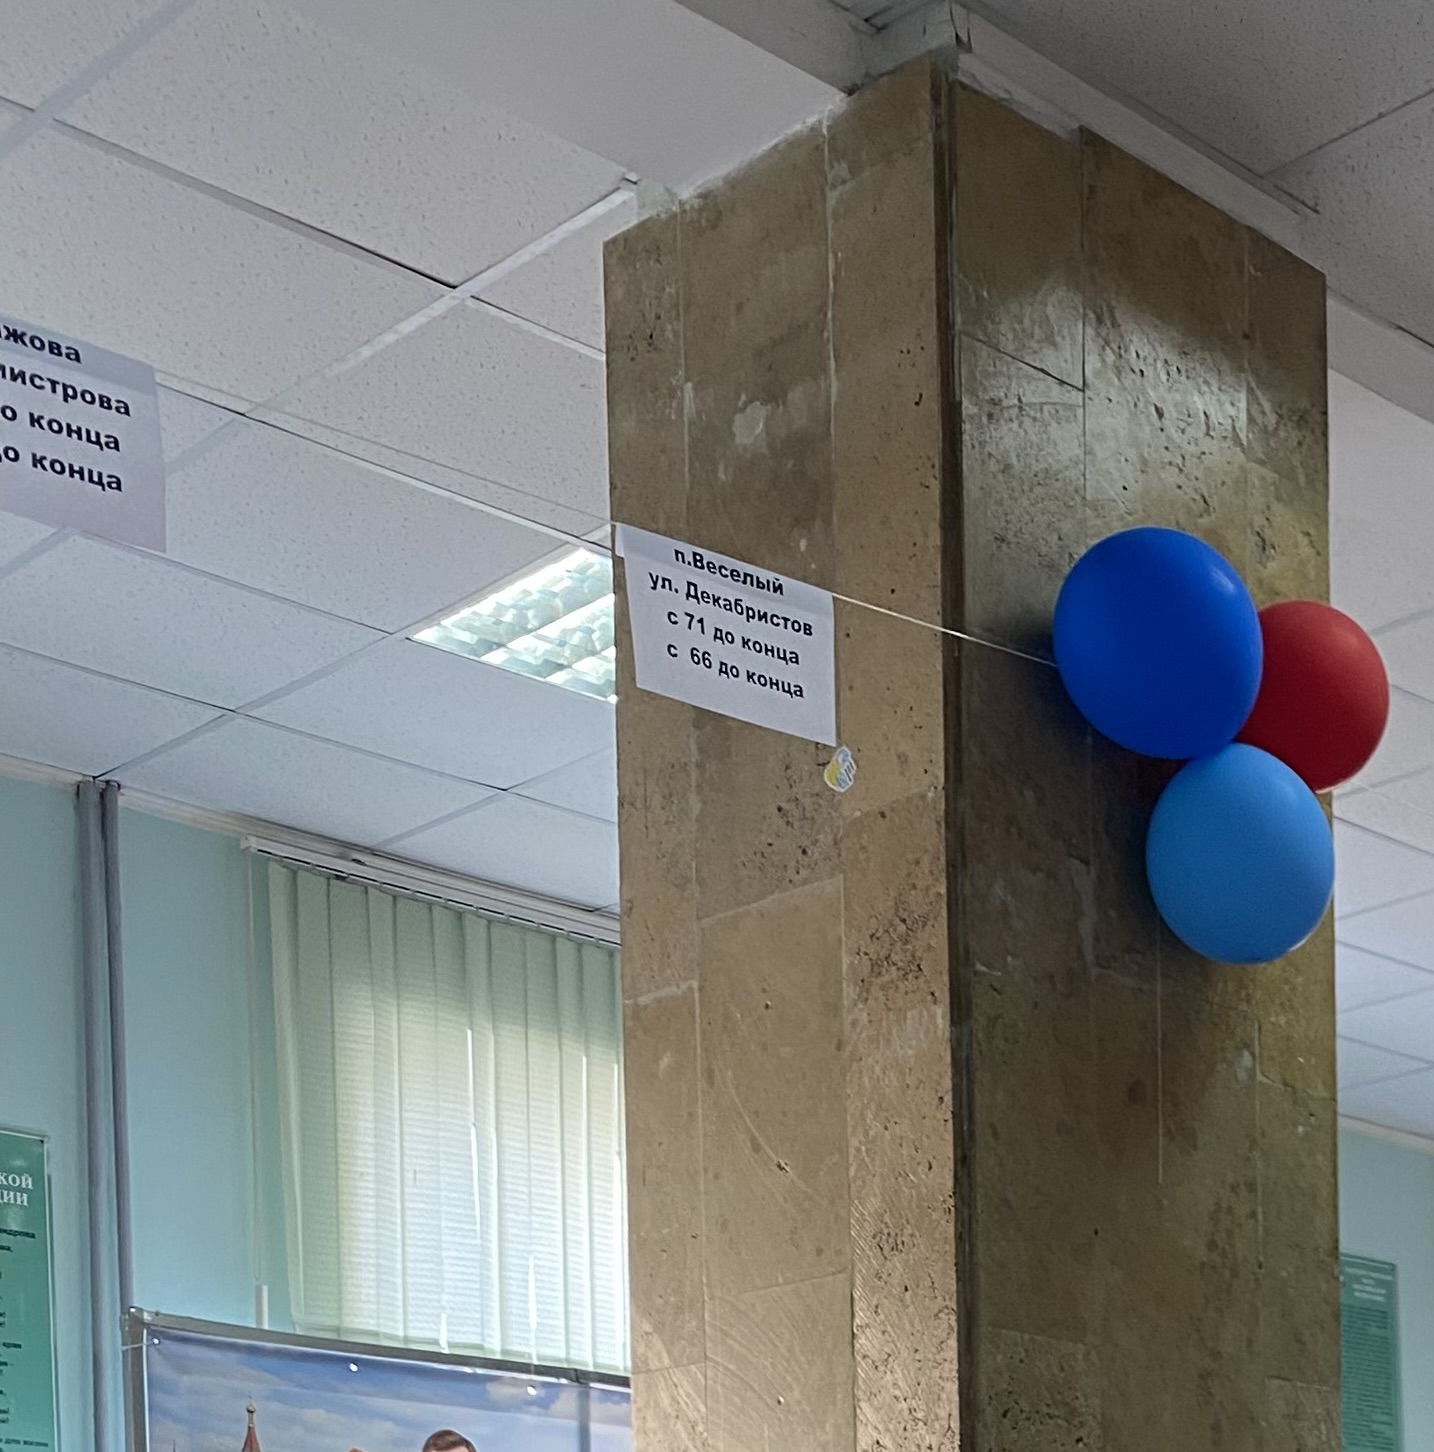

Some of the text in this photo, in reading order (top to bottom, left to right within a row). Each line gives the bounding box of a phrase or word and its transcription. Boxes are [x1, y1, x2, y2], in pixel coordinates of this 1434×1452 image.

[0, 323, 82, 365] жова
[28, 411, 121, 452] конца
[0, 445, 123, 493] о конца
[674, 548, 784, 596] п.Веселый
[648, 571, 813, 636] ул. Декабристов
[667, 610, 800, 665] с 71 до конца
[667, 644, 804, 698] с 66 до конца
